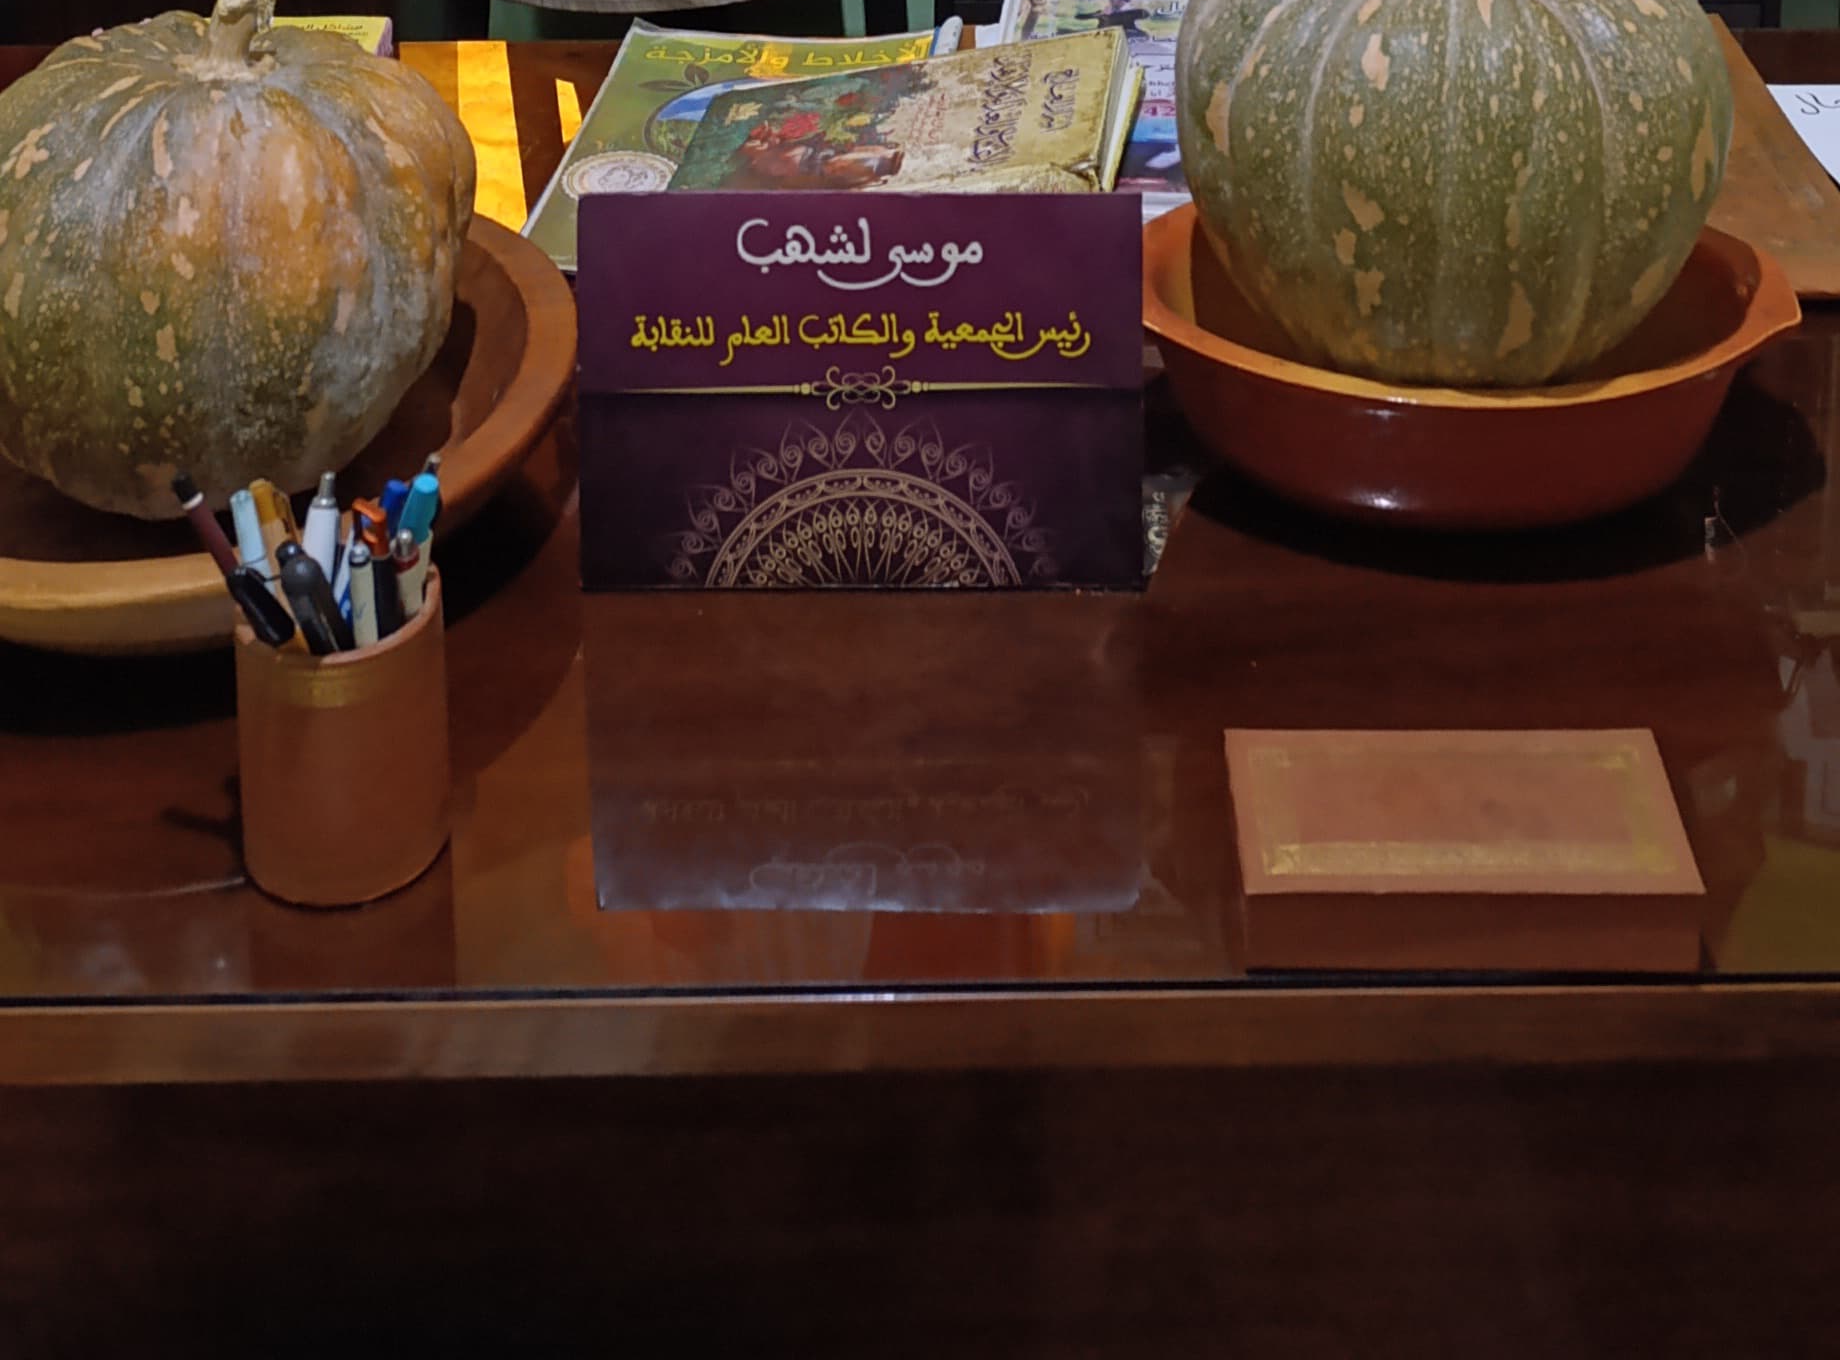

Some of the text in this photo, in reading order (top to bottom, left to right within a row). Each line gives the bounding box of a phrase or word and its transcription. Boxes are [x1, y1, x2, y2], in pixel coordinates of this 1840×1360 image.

[736, 217, 985, 291] موسى لشهب
[629, 310, 1092, 367] رئيس الجمعية والكاتب العام للنقابة
